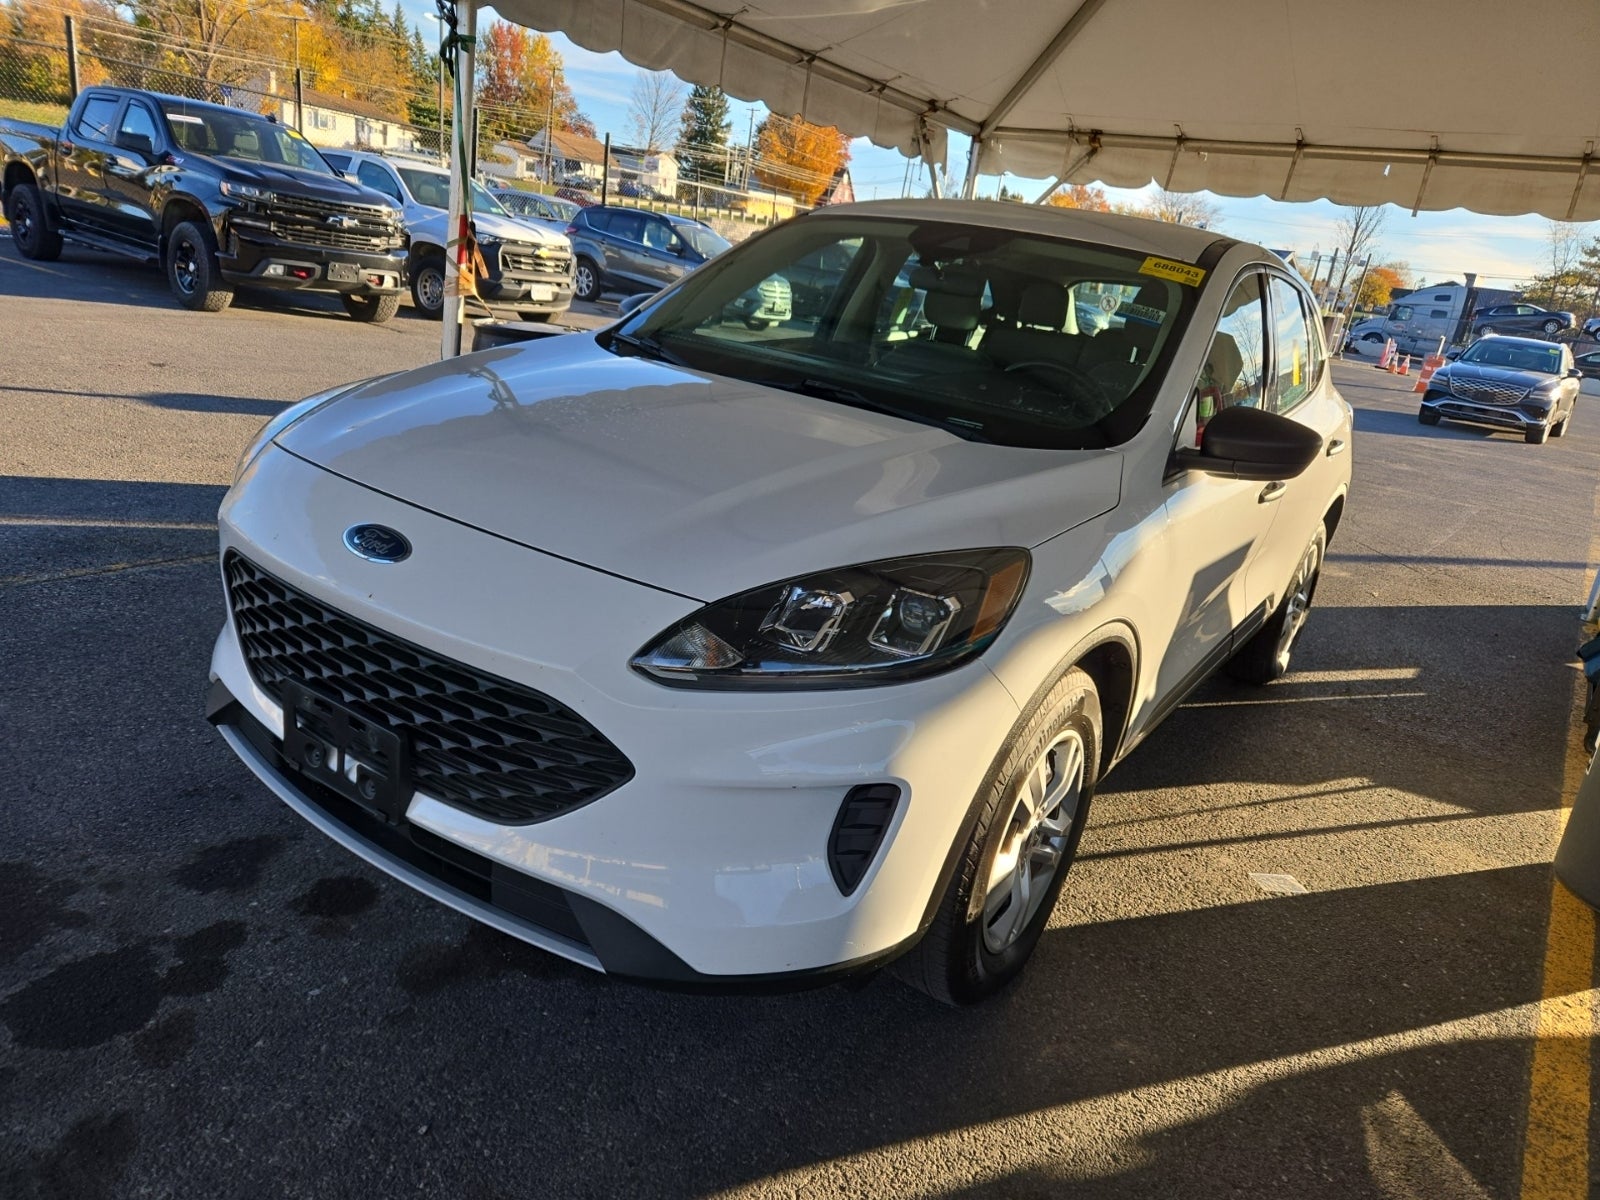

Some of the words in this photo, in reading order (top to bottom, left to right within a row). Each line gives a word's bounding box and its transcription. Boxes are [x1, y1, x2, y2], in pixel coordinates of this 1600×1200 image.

[1154, 262, 1199, 278] 688043
[354, 529, 395, 554] Ford
[1024, 698, 1073, 770] Continental
